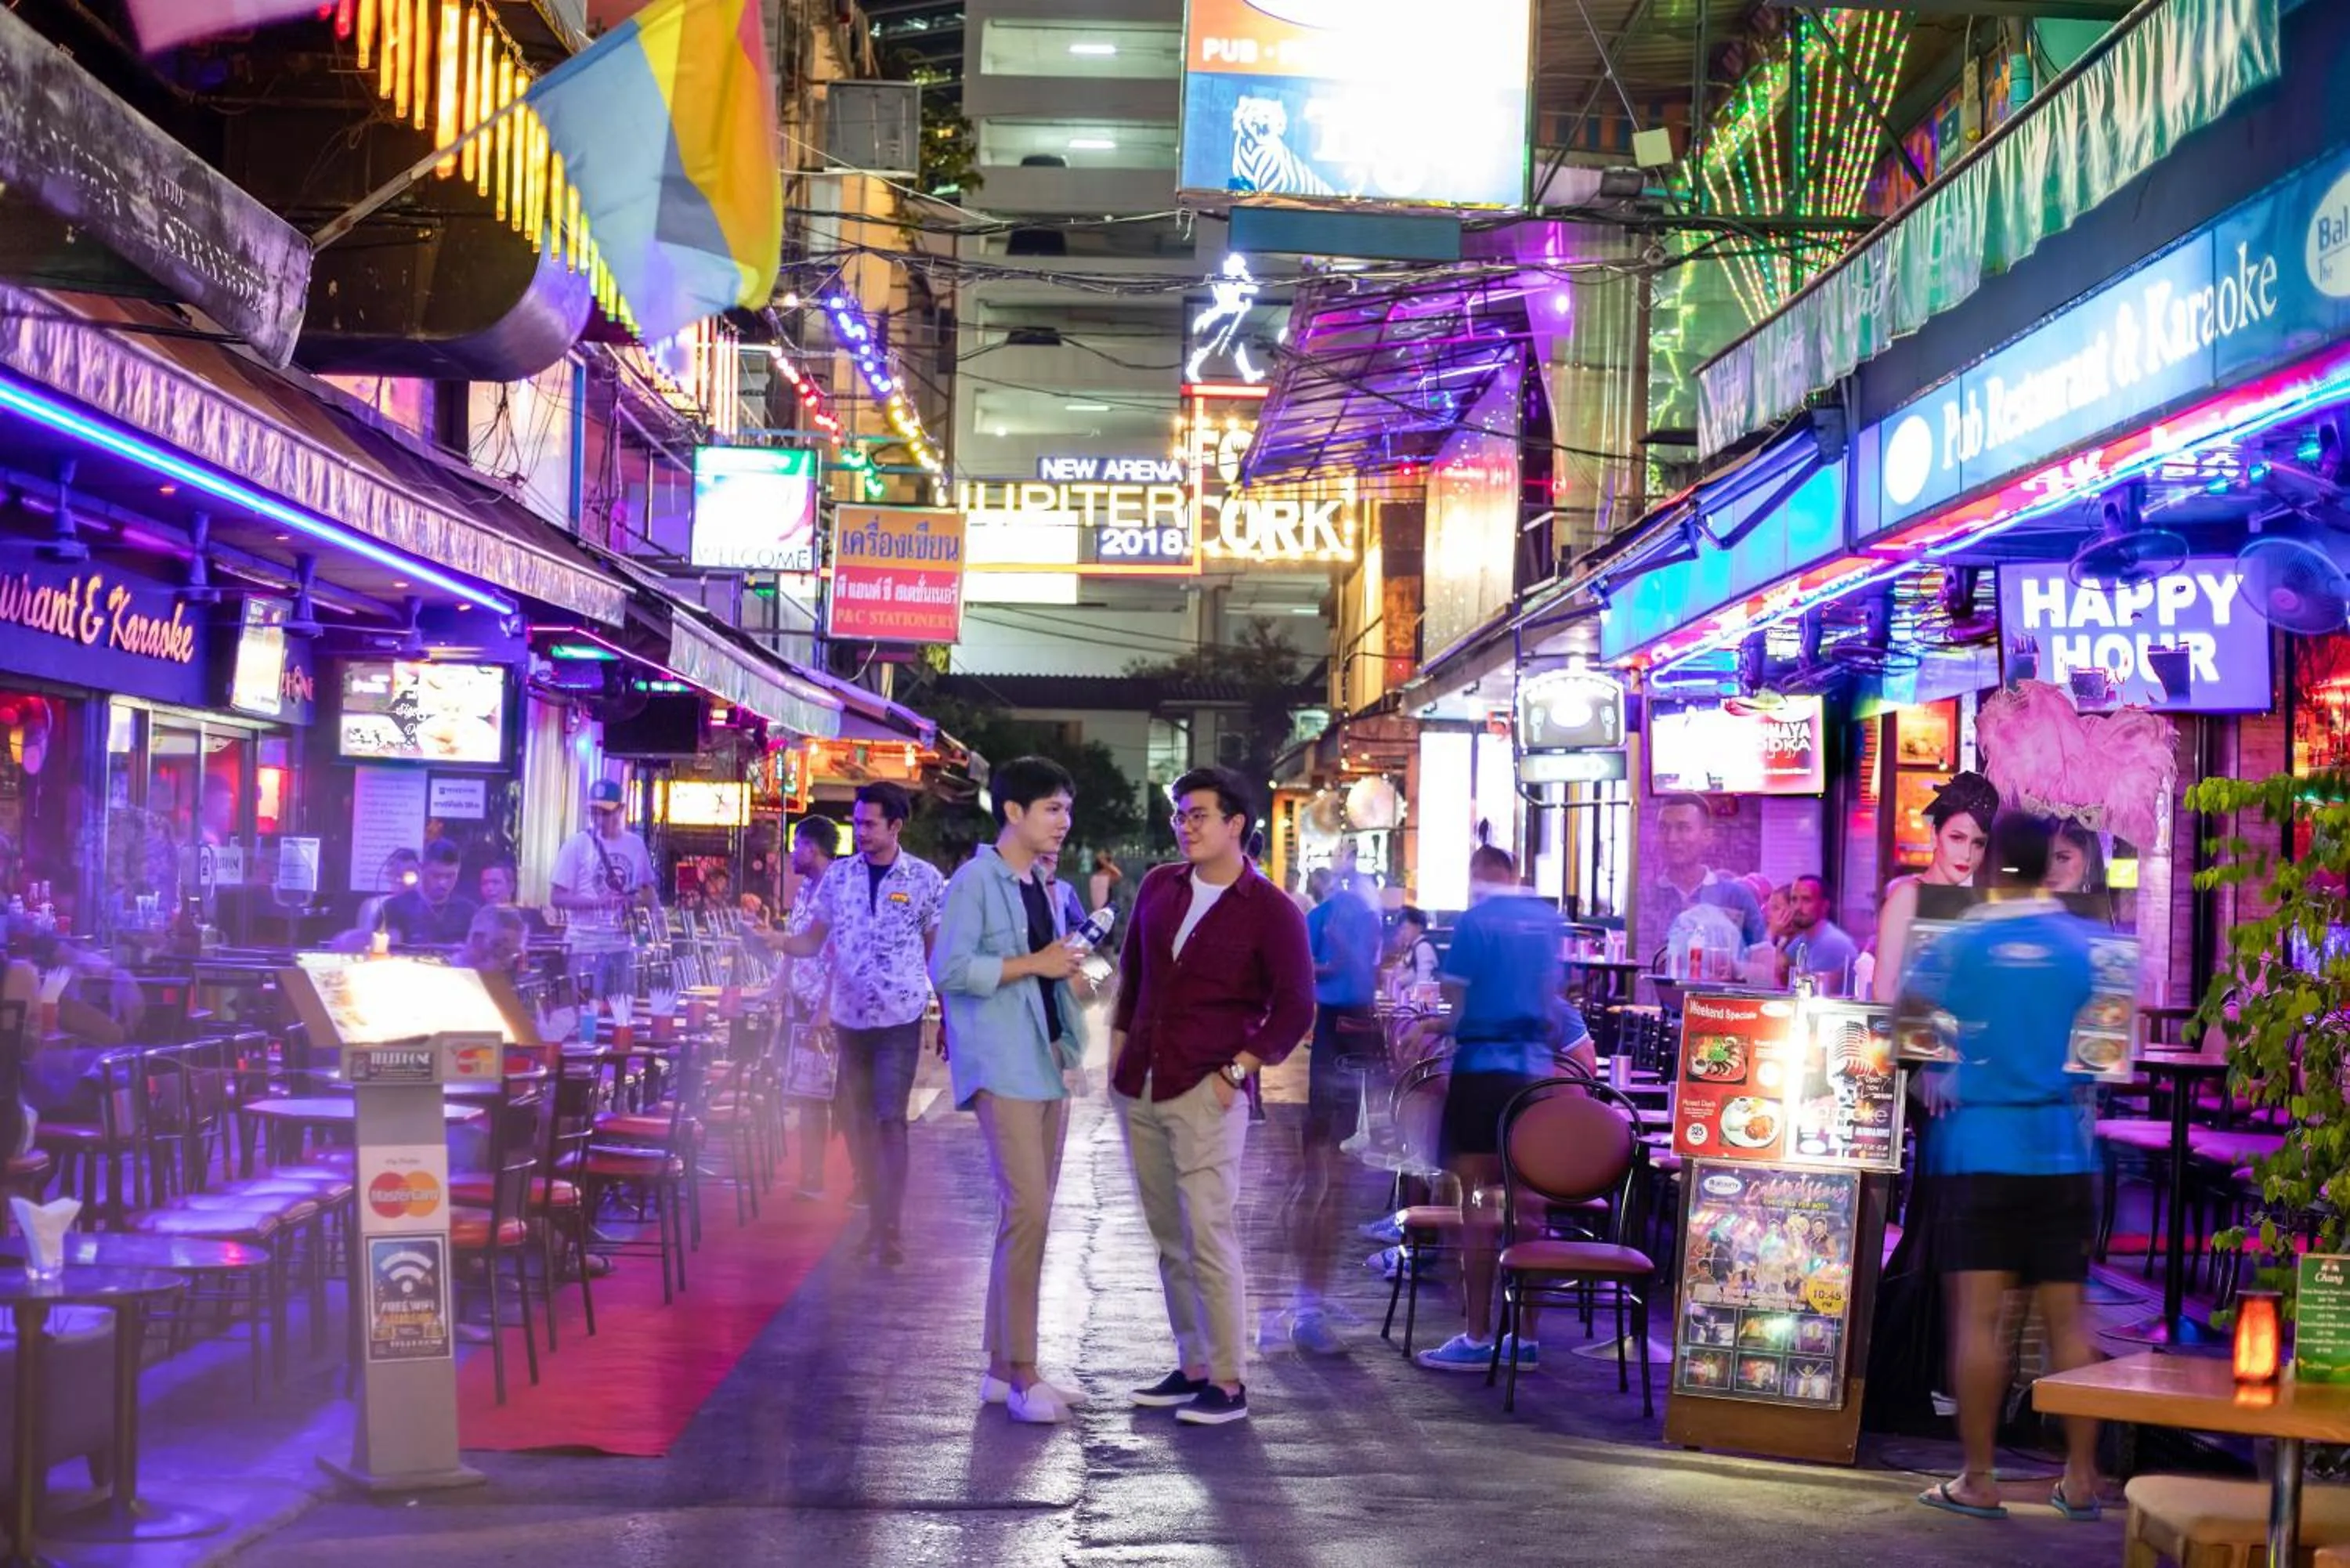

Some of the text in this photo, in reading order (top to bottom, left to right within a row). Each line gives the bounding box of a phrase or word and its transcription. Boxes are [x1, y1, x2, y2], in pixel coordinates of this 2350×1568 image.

[1202, 38, 1258, 63] PUB
[1943, 241, 2279, 470] Pub Restaurant & Karaoke
[1040, 458, 1184, 482] NEW ARENA
[958, 483, 1187, 527] JUPITER
[842, 515, 959, 562] เครื่องเขียน
[1100, 528, 1184, 555] 2018
[80, 575, 104, 645] &
[107, 585, 193, 663] Karaoke
[835, 608, 954, 631] P&C STATIONERY
[2021, 573, 2244, 628] HAPPY
[2051, 631, 2221, 684] HOUR
[2314, 1272, 2345, 1285] Chang
